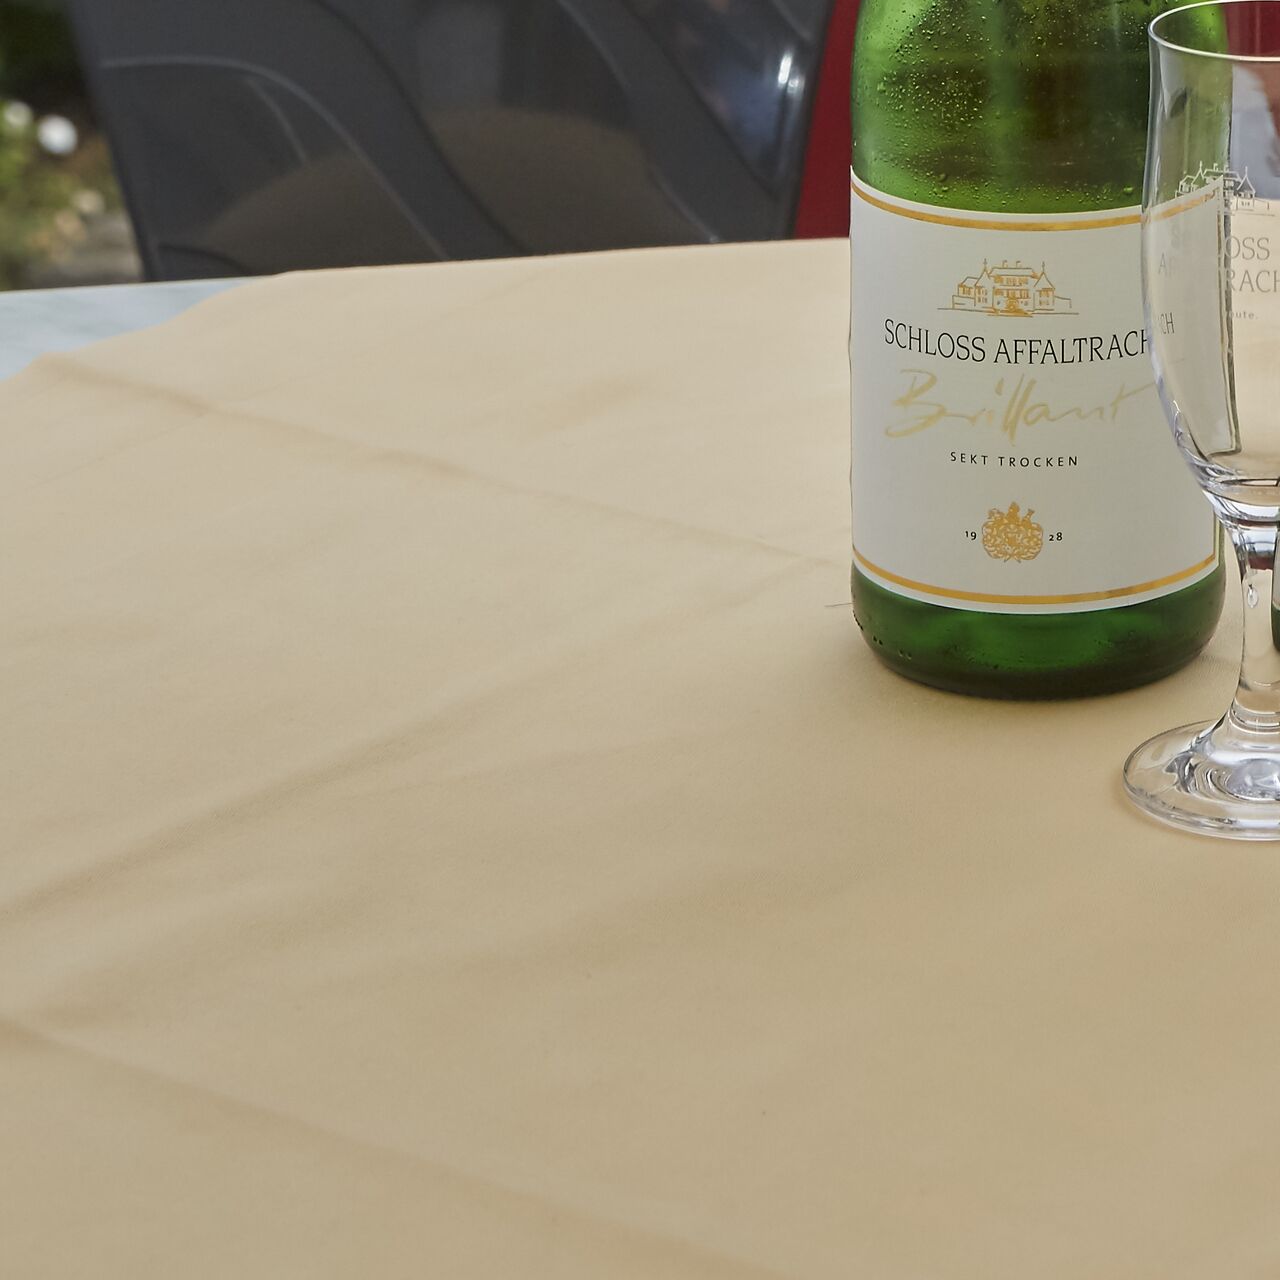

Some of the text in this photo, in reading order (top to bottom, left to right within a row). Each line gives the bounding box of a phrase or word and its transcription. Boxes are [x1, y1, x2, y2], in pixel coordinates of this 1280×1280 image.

[884, 318, 1149, 365] SCHLOSS AFFALTRACH
[885, 369, 1156, 447] Brillant
[950, 451, 1078, 468] SEKT TROCKEN
[965, 530, 1063, 542] 19 28
